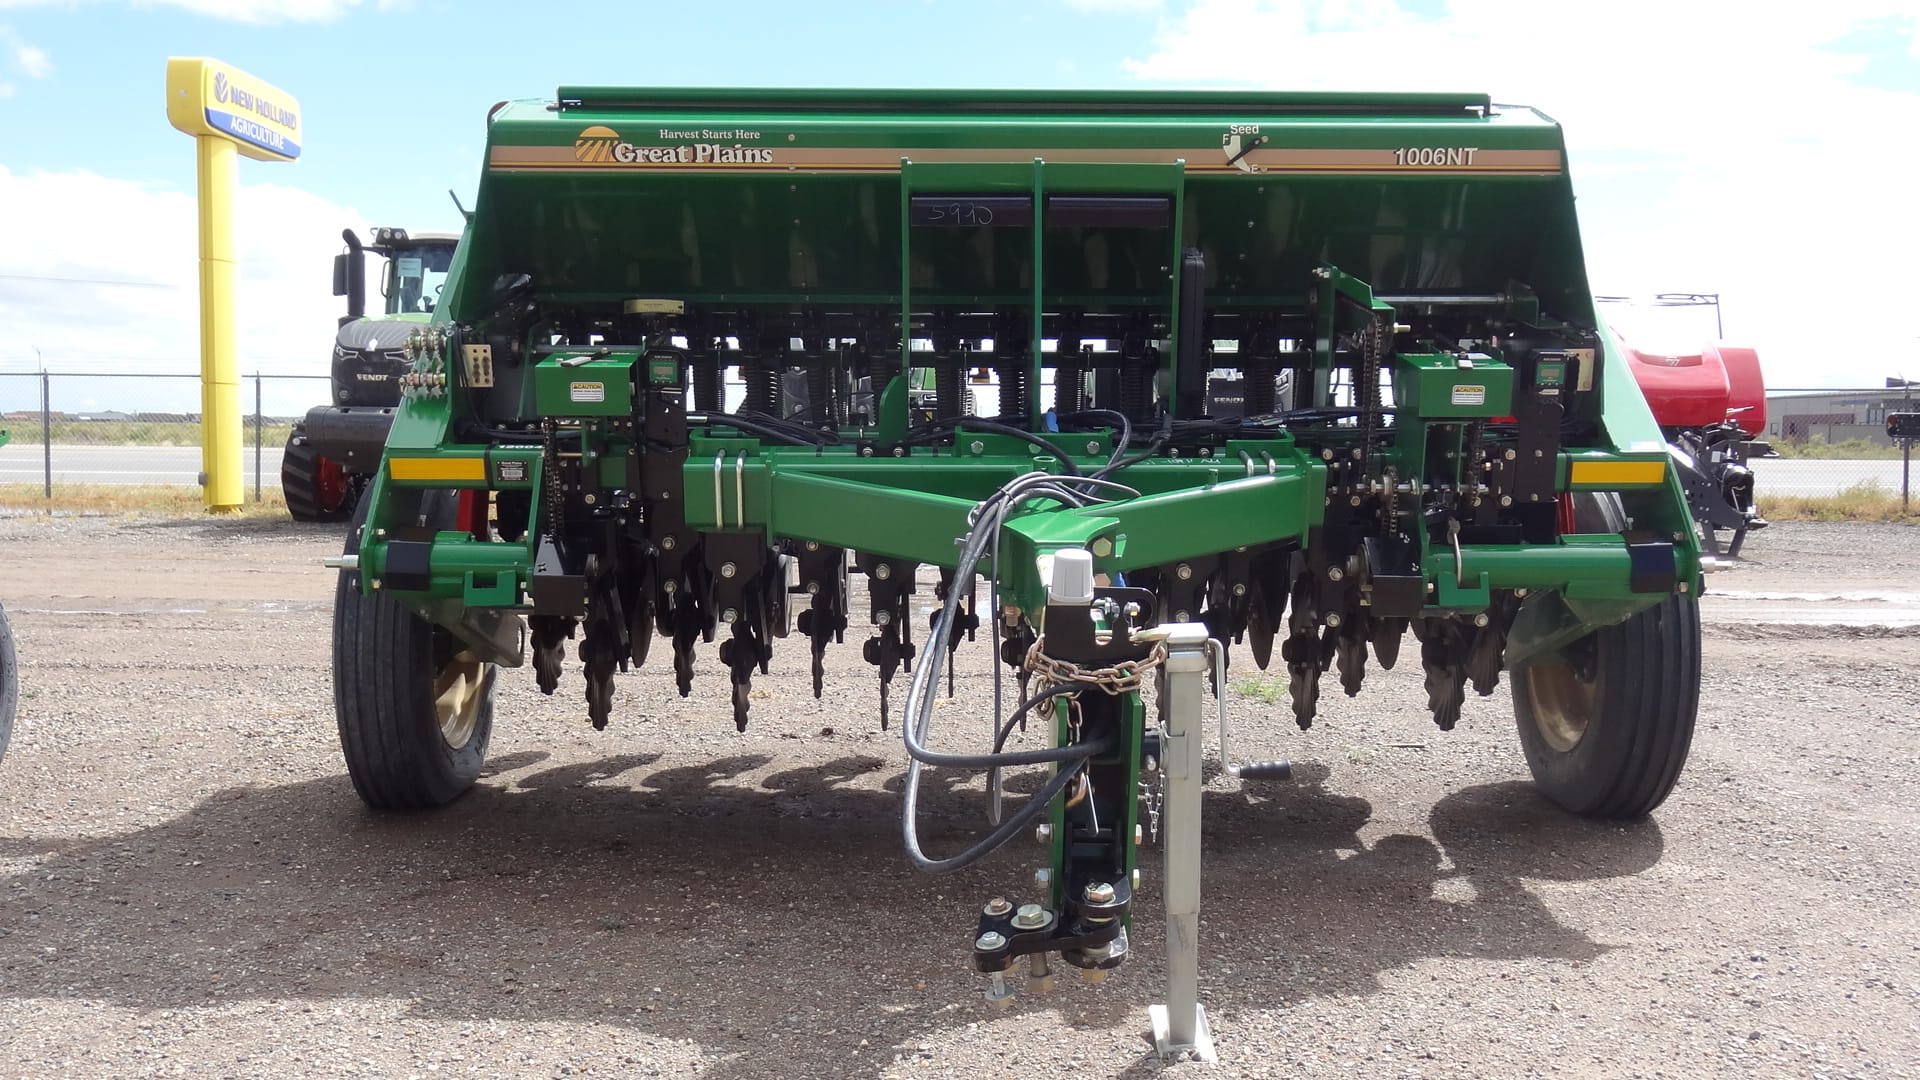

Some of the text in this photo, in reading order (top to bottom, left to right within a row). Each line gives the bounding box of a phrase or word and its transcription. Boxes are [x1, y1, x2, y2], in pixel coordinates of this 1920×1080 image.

[231, 86, 297, 130] NEW HOLLAND
[230, 115, 285, 150] AGRICULTURE
[660, 129, 761, 139] Harvest Starts Here
[1230, 124, 1259, 135] Seed
[614, 143, 773, 163] Great Plains
[1394, 147, 1478, 166] 1006NT
[356, 373, 389, 381] FENDT
